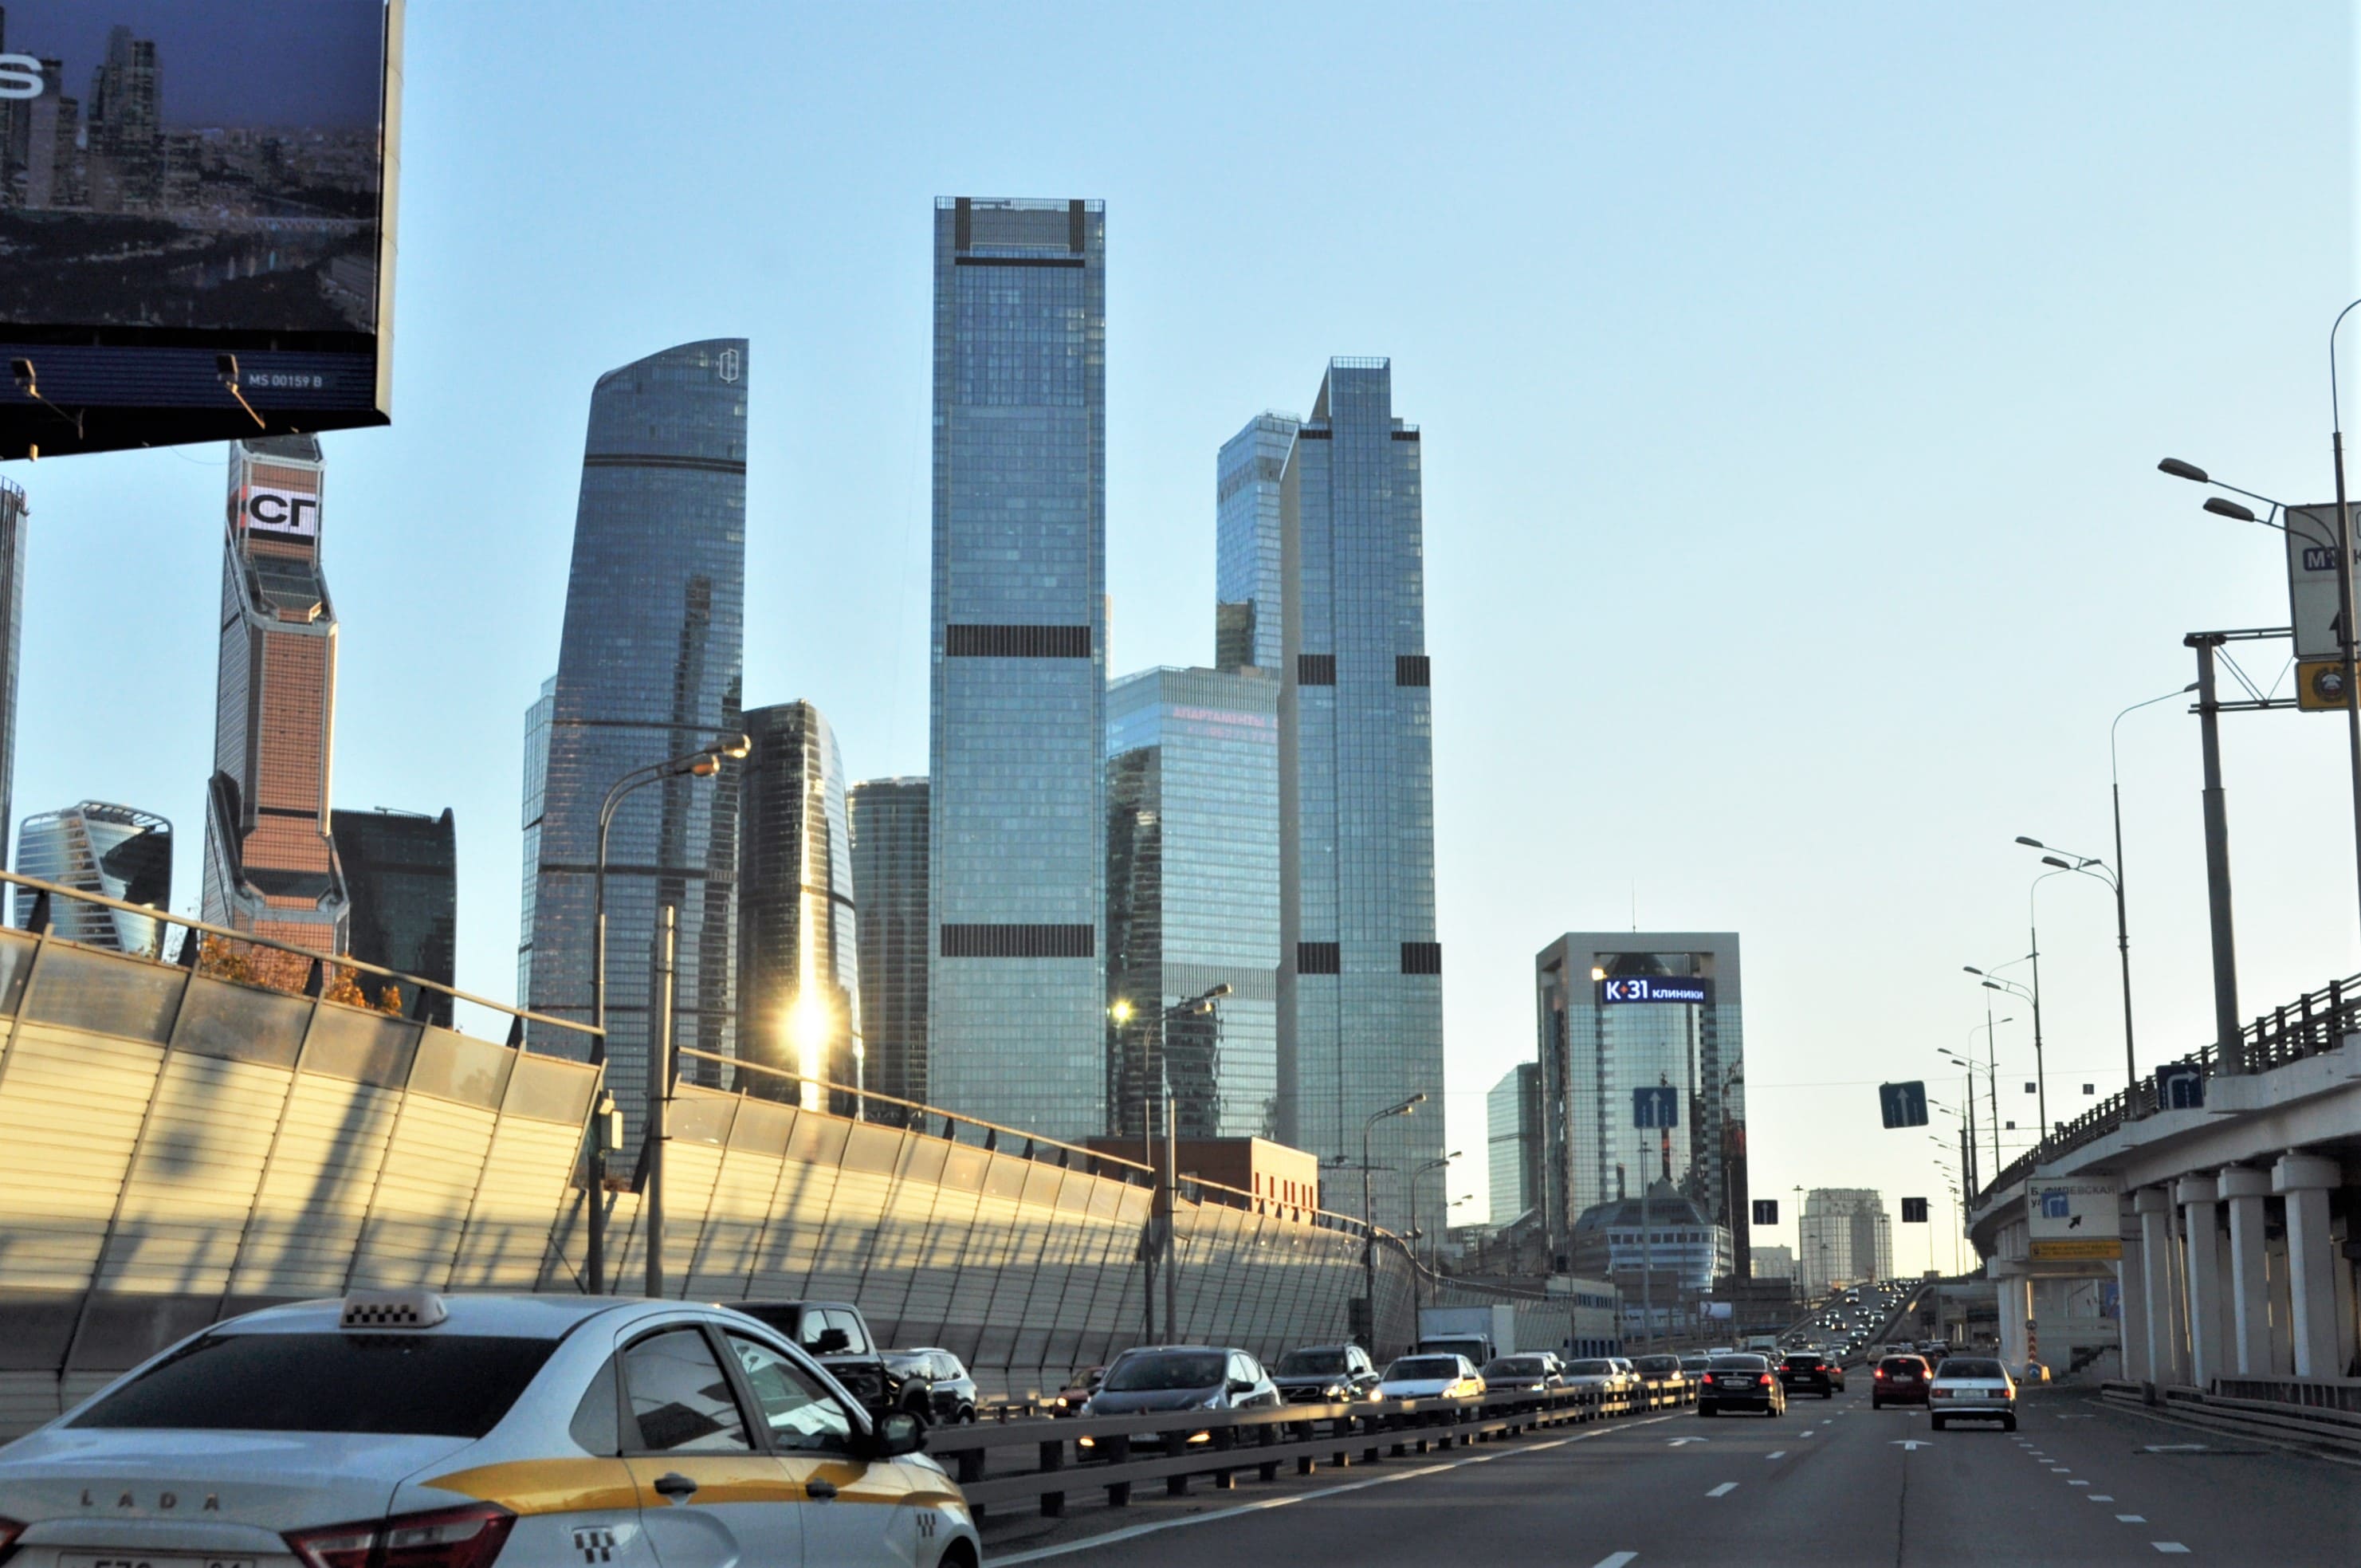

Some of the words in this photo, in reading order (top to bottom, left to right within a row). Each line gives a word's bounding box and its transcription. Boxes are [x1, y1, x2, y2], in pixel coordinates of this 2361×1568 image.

[249, 374, 269, 387] MS
[272, 374, 310, 387] 00159
[1652, 988, 1704, 1000] клиники
[81, 1488, 221, 1511] LADA
